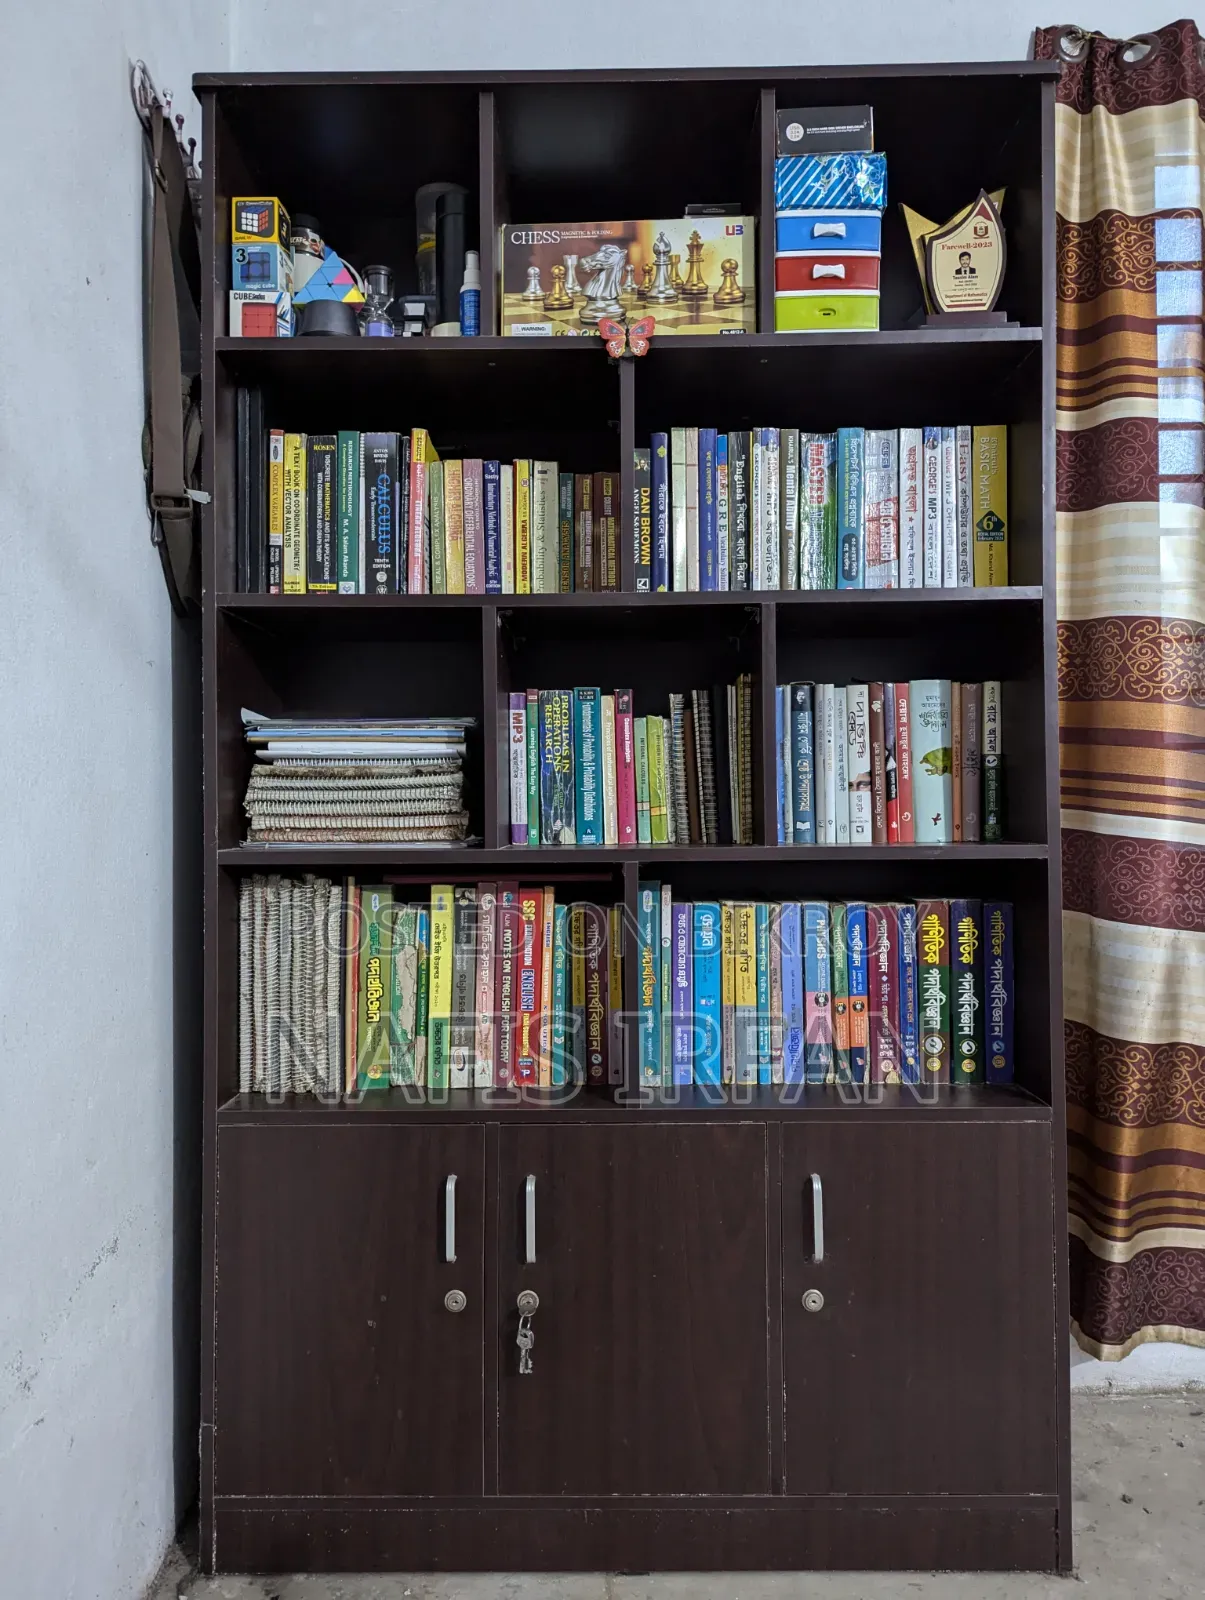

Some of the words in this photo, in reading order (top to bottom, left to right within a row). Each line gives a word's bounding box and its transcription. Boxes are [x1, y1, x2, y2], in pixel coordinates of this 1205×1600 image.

[511, 230, 560, 244] CHESS
[942, 242, 992, 250] Farewell-2023
[904, 446, 917, 482] অগ্রদূত
[959, 444, 969, 484] Easy
[980, 437, 989, 470] BASIC
[786, 465, 796, 498] Mental
[810, 443, 825, 504] MASTER
[850, 471, 859, 496] বিসিএস
[294, 489, 300, 498] ON
[464, 478, 473, 509] ORDINARY
[486, 483, 496, 510] Introductory
[641, 488, 650, 513] DAN
[658, 483, 668, 510] সীরাতে
[905, 484, 918, 512] বাংলা
[980, 475, 990, 509] MATH
[377, 474, 390, 553] CALCULUS
[487, 511, 496, 529] Methods
[537, 490, 545, 531] Statistics
[785, 500, 796, 530] Ability
[928, 498, 936, 519] MP3
[960, 488, 969, 528] কম্পিউটার
[465, 510, 474, 551] DIFFERENTIAL
[537, 534, 545, 542] &
[561, 520, 570, 559] ANALYSIS
[641, 518, 650, 565] BROWN
[488, 536, 497, 558] Numerical
[658, 536, 666, 558] হিশাম
[718, 536, 726, 566] Vocabulary
[737, 537, 745, 559] বাংলা
[960, 541, 968, 557] তথ্য
[466, 553, 476, 587] EQUATIONS
[959, 560, 970, 582] প্রযুক্তি
[561, 695, 570, 755] PROBLEMS
[582, 702, 595, 732] Fundamentals
[899, 699, 907, 722] দেয়াল
[986, 705, 996, 723] রাহে
[513, 712, 523, 743] MP3
[545, 705, 553, 763] RESEARCH
[553, 697, 561, 772] OPERATIONS
[988, 727, 997, 752] আমল
[580, 739, 595, 761] Probability
[563, 760, 570, 772] IN
[580, 767, 595, 790] Probability
[901, 752, 909, 780] আহমেদ
[584, 792, 596, 820] Distributions
[523, 900, 536, 920] SSC
[678, 914, 686, 928] তথ্য
[481, 915, 492, 952] গাণিতিক
[503, 929, 512, 958] NOTES
[700, 914, 714, 947] রসায়ন
[739, 911, 751, 946] উচ্চতর
[816, 920, 826, 959] PHYSICS
[922, 914, 944, 964] গাণিতিক
[957, 917, 978, 964] গাণিতিক
[991, 911, 1005, 956] গাণিতিক
[524, 924, 533, 965] EXAMINATION
[587, 923, 601, 970] গাণিতিক
[677, 935, 686, 969] যোগাযোগ
[852, 924, 863, 966] পদার্থবিজ্ঞান
[877, 919, 890, 972] পদার্থবিজ্ঞান
[503, 960, 511, 972] ON
[740, 948, 753, 973] গণিত
[366, 958, 384, 1022] পদার্থবিজ্ঞান
[457, 974, 467, 995] গণিত
[521, 969, 534, 1011] ENGLISH
[642, 946, 656, 1007] পদার্থবিজ্ঞান
[677, 970, 688, 988] প্রযুক্তি
[502, 976, 511, 1011] ENGLISH
[923, 968, 946, 1029] পদার্থবিজ্ঞান
[958, 972, 978, 1035] পদার্থবিজ্ঞান
[990, 959, 1007, 1037] পদার্থবিজ্ঞান
[502, 1015, 510, 1030] FOR
[588, 972, 604, 1051] পদার্থবিজ্ঞান
[434, 1022, 442, 1045] উচ্চতর
[500, 1034, 510, 1062] TODAY
[434, 1047, 442, 1064] গণিত
